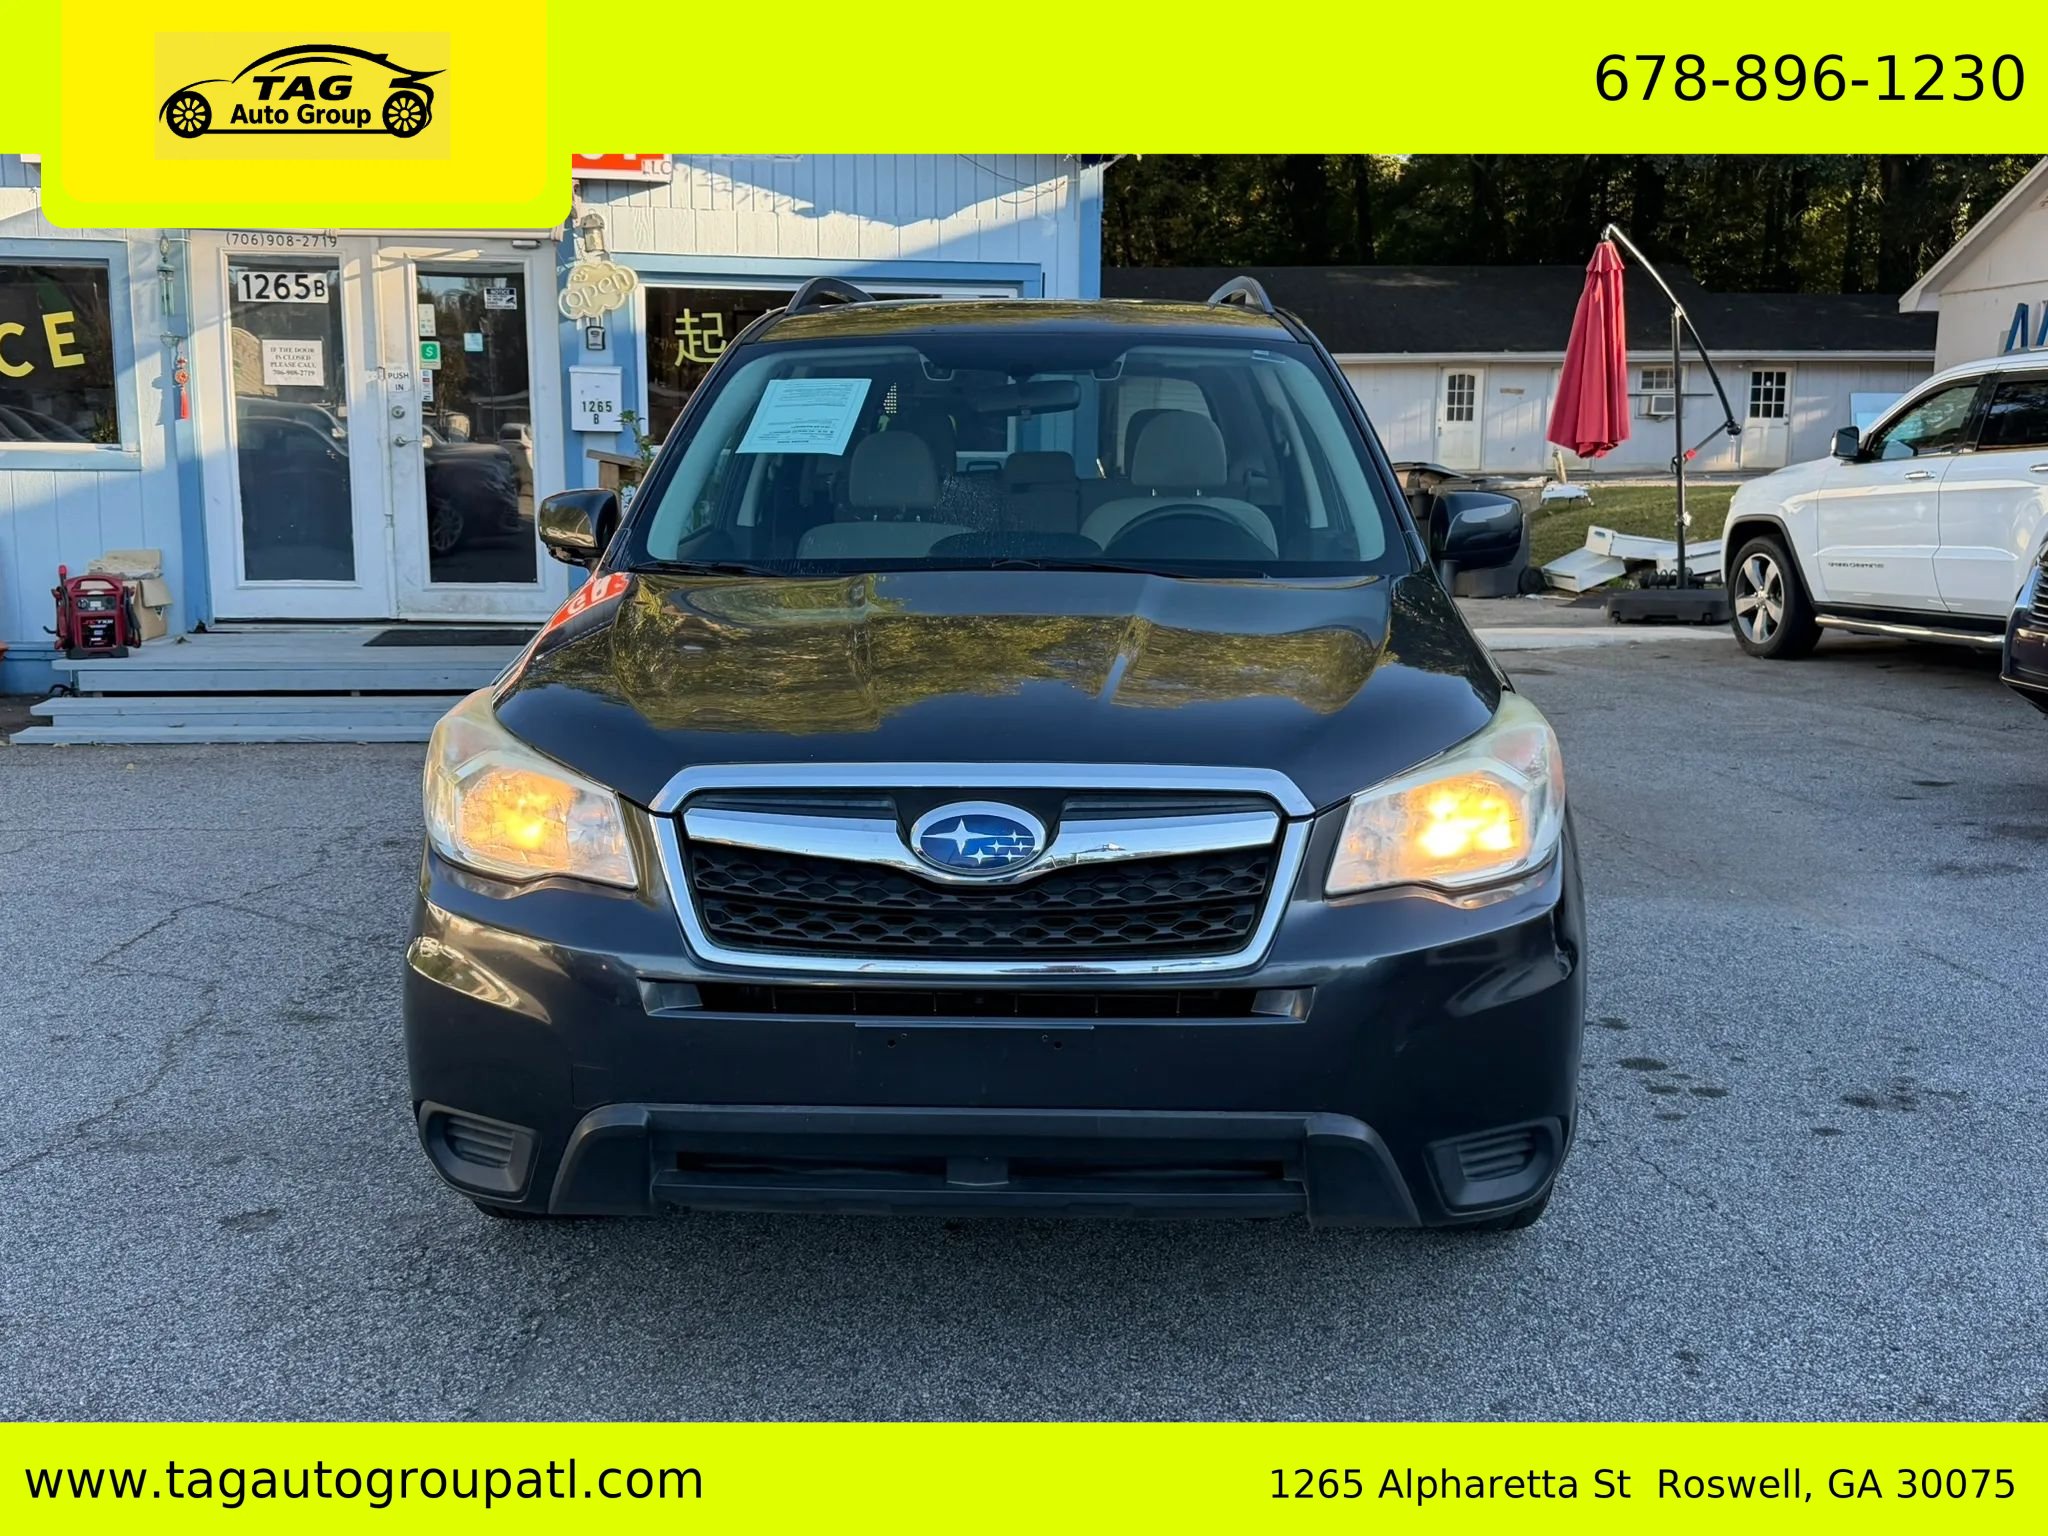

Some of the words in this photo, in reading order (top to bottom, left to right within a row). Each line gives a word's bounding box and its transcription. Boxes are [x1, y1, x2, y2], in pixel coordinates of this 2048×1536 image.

[642, 160, 671, 175] LLC
[226, 232, 337, 247] (706)908-2719
[242, 274, 310, 299] 1265
[314, 280, 325, 297] B
[566, 272, 630, 307] open
[674, 308, 727, 367] 起
[582, 401, 612, 412] 1265
[593, 413, 599, 424] B
